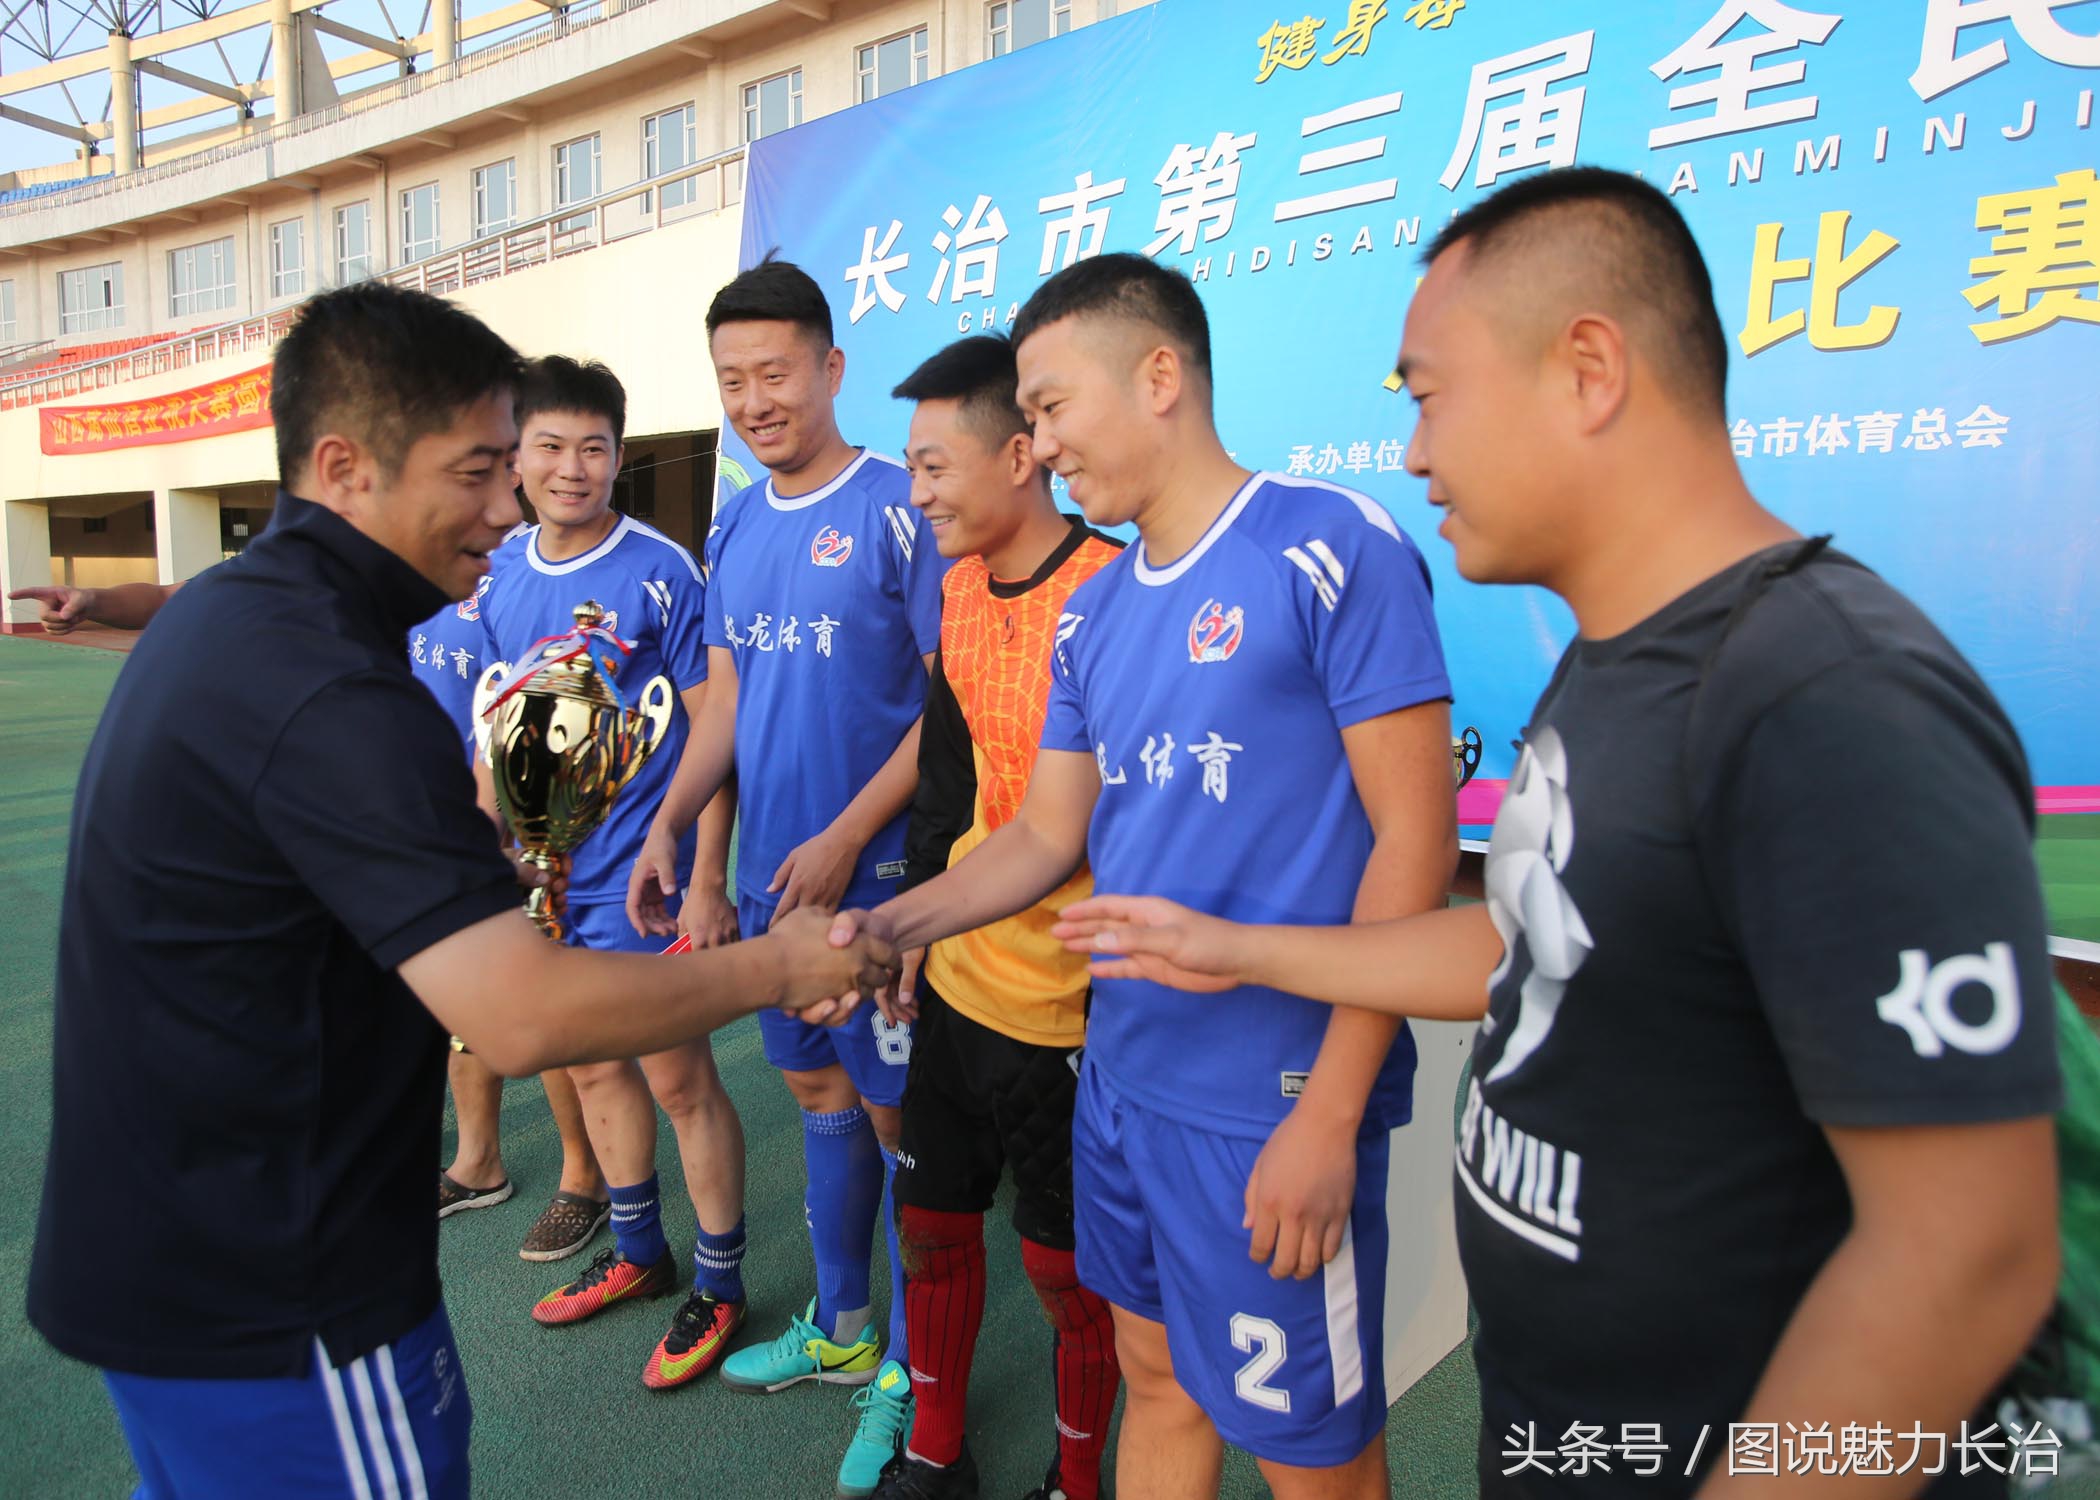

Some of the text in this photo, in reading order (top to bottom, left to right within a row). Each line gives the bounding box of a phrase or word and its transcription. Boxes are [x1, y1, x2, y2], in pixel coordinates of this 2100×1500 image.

[1286, 439, 1404, 475] 承办单位
[871, 1008, 913, 1066] 8
[880, 1368, 900, 1392] NIKE
[1229, 1311, 1291, 1413] 2
